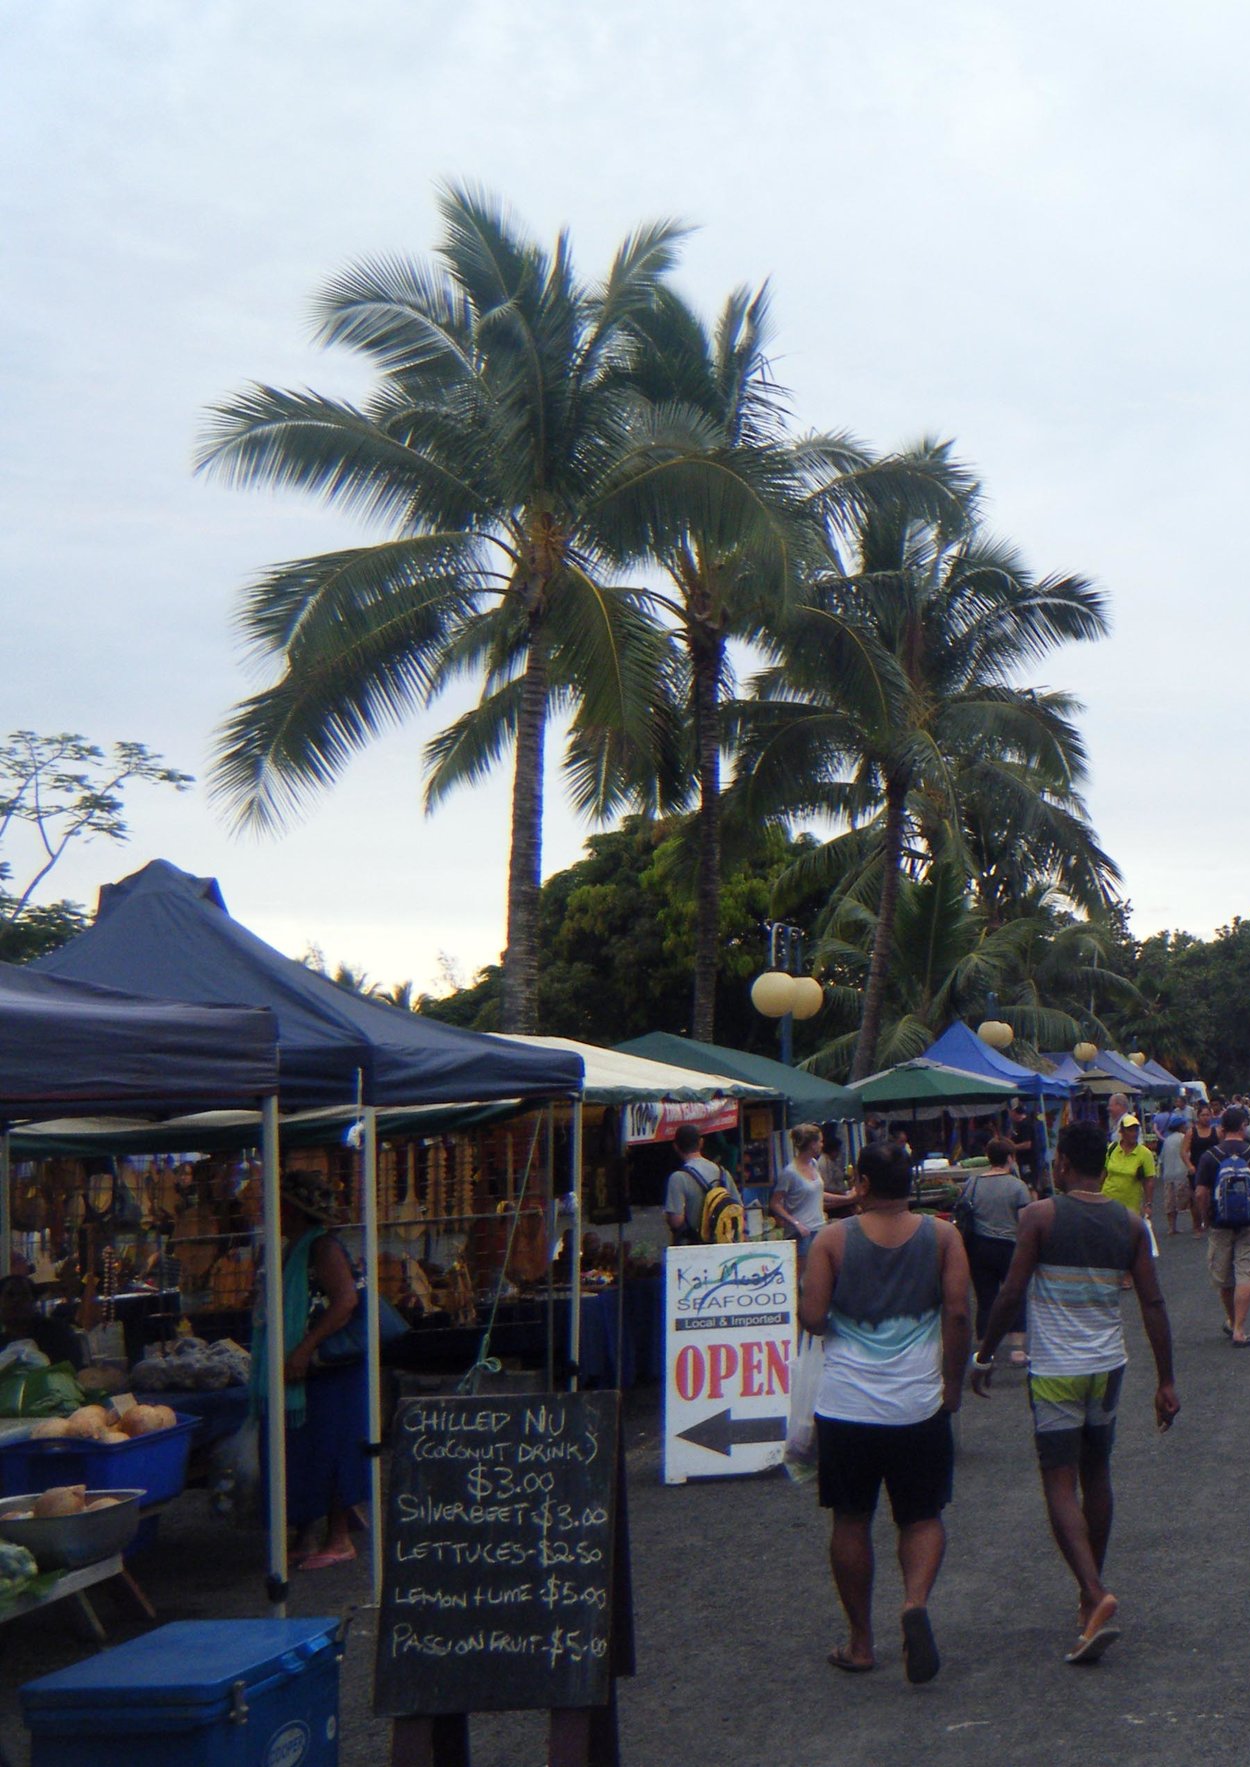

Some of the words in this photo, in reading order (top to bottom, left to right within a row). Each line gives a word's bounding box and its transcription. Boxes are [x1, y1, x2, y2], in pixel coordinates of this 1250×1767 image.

[677, 1266, 708, 1290] Kai
[677, 1293, 787, 1311] SEAFOOD
[685, 1318, 715, 1329] Local
[719, 1316, 728, 1326] &
[731, 1314, 782, 1327] Imported
[675, 1340, 791, 1401] OPEN
[402, 1406, 511, 1432] CHILLED
[525, 1405, 565, 1437] NU
[413, 1435, 511, 1462] (COCONUT
[467, 1462, 555, 1502] $3.00
[395, 1584, 468, 1609] LEMON
[488, 1583, 533, 1605] LIME
